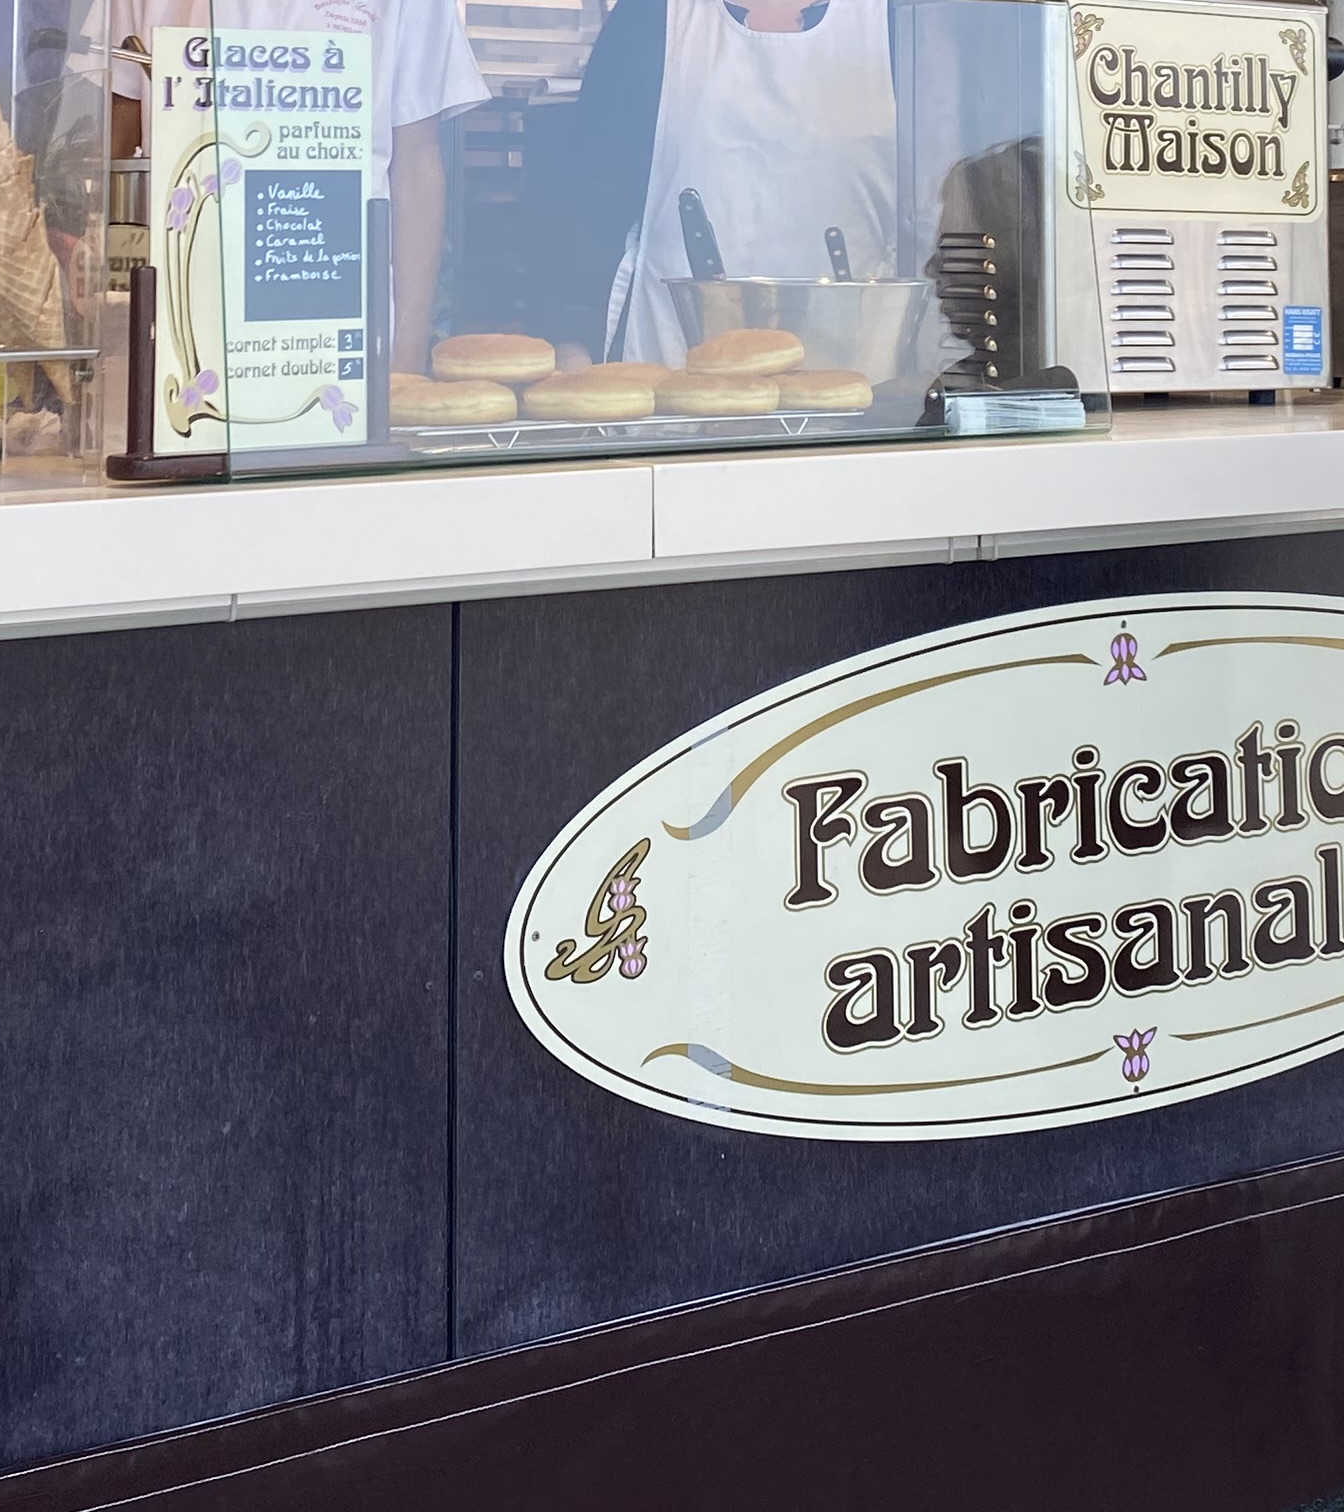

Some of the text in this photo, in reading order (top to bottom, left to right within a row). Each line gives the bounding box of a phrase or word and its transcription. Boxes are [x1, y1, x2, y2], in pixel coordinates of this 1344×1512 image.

[183, 36, 345, 72] Glaces à
[1086, 43, 1300, 130] Chantilly
[279, 121, 361, 142] parfums
[277, 143, 363, 160] au choix:
[1101, 111, 1288, 180] Maison
[268, 182, 324, 200] Vanille
[267, 203, 309, 216] Fraise
[266, 219, 322, 231] Chocolat
[265, 234, 326, 247] Caramel
[265, 269, 342, 281] Framboise
[226, 336, 276, 353] cornet
[281, 334, 336, 352] simple:
[227, 362, 276, 379] cornet
[281, 359, 336, 376] double:
